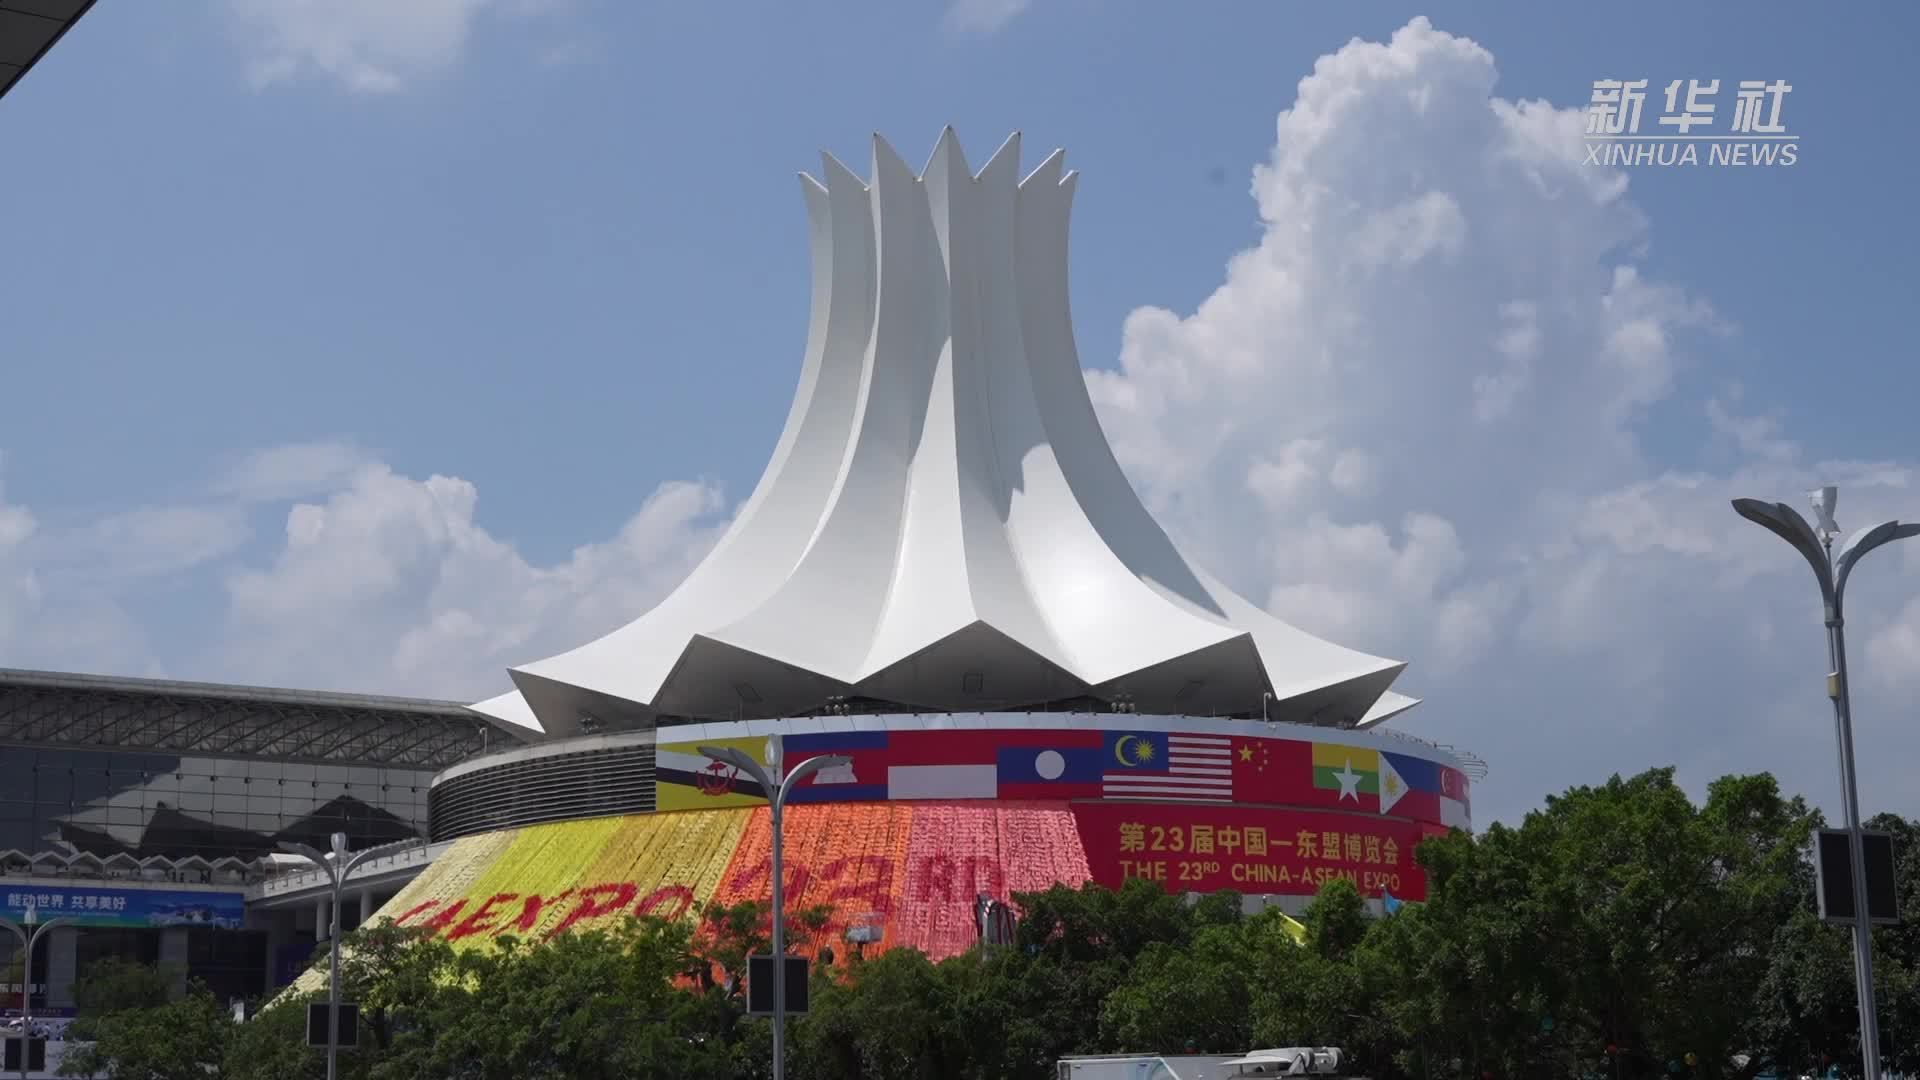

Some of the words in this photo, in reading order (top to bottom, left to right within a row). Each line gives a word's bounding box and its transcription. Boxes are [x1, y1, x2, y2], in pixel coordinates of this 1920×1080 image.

[1119, 860, 1168, 881] THE
[1178, 861, 1221, 881] 23RD
[1363, 871, 1400, 891] EXPO
